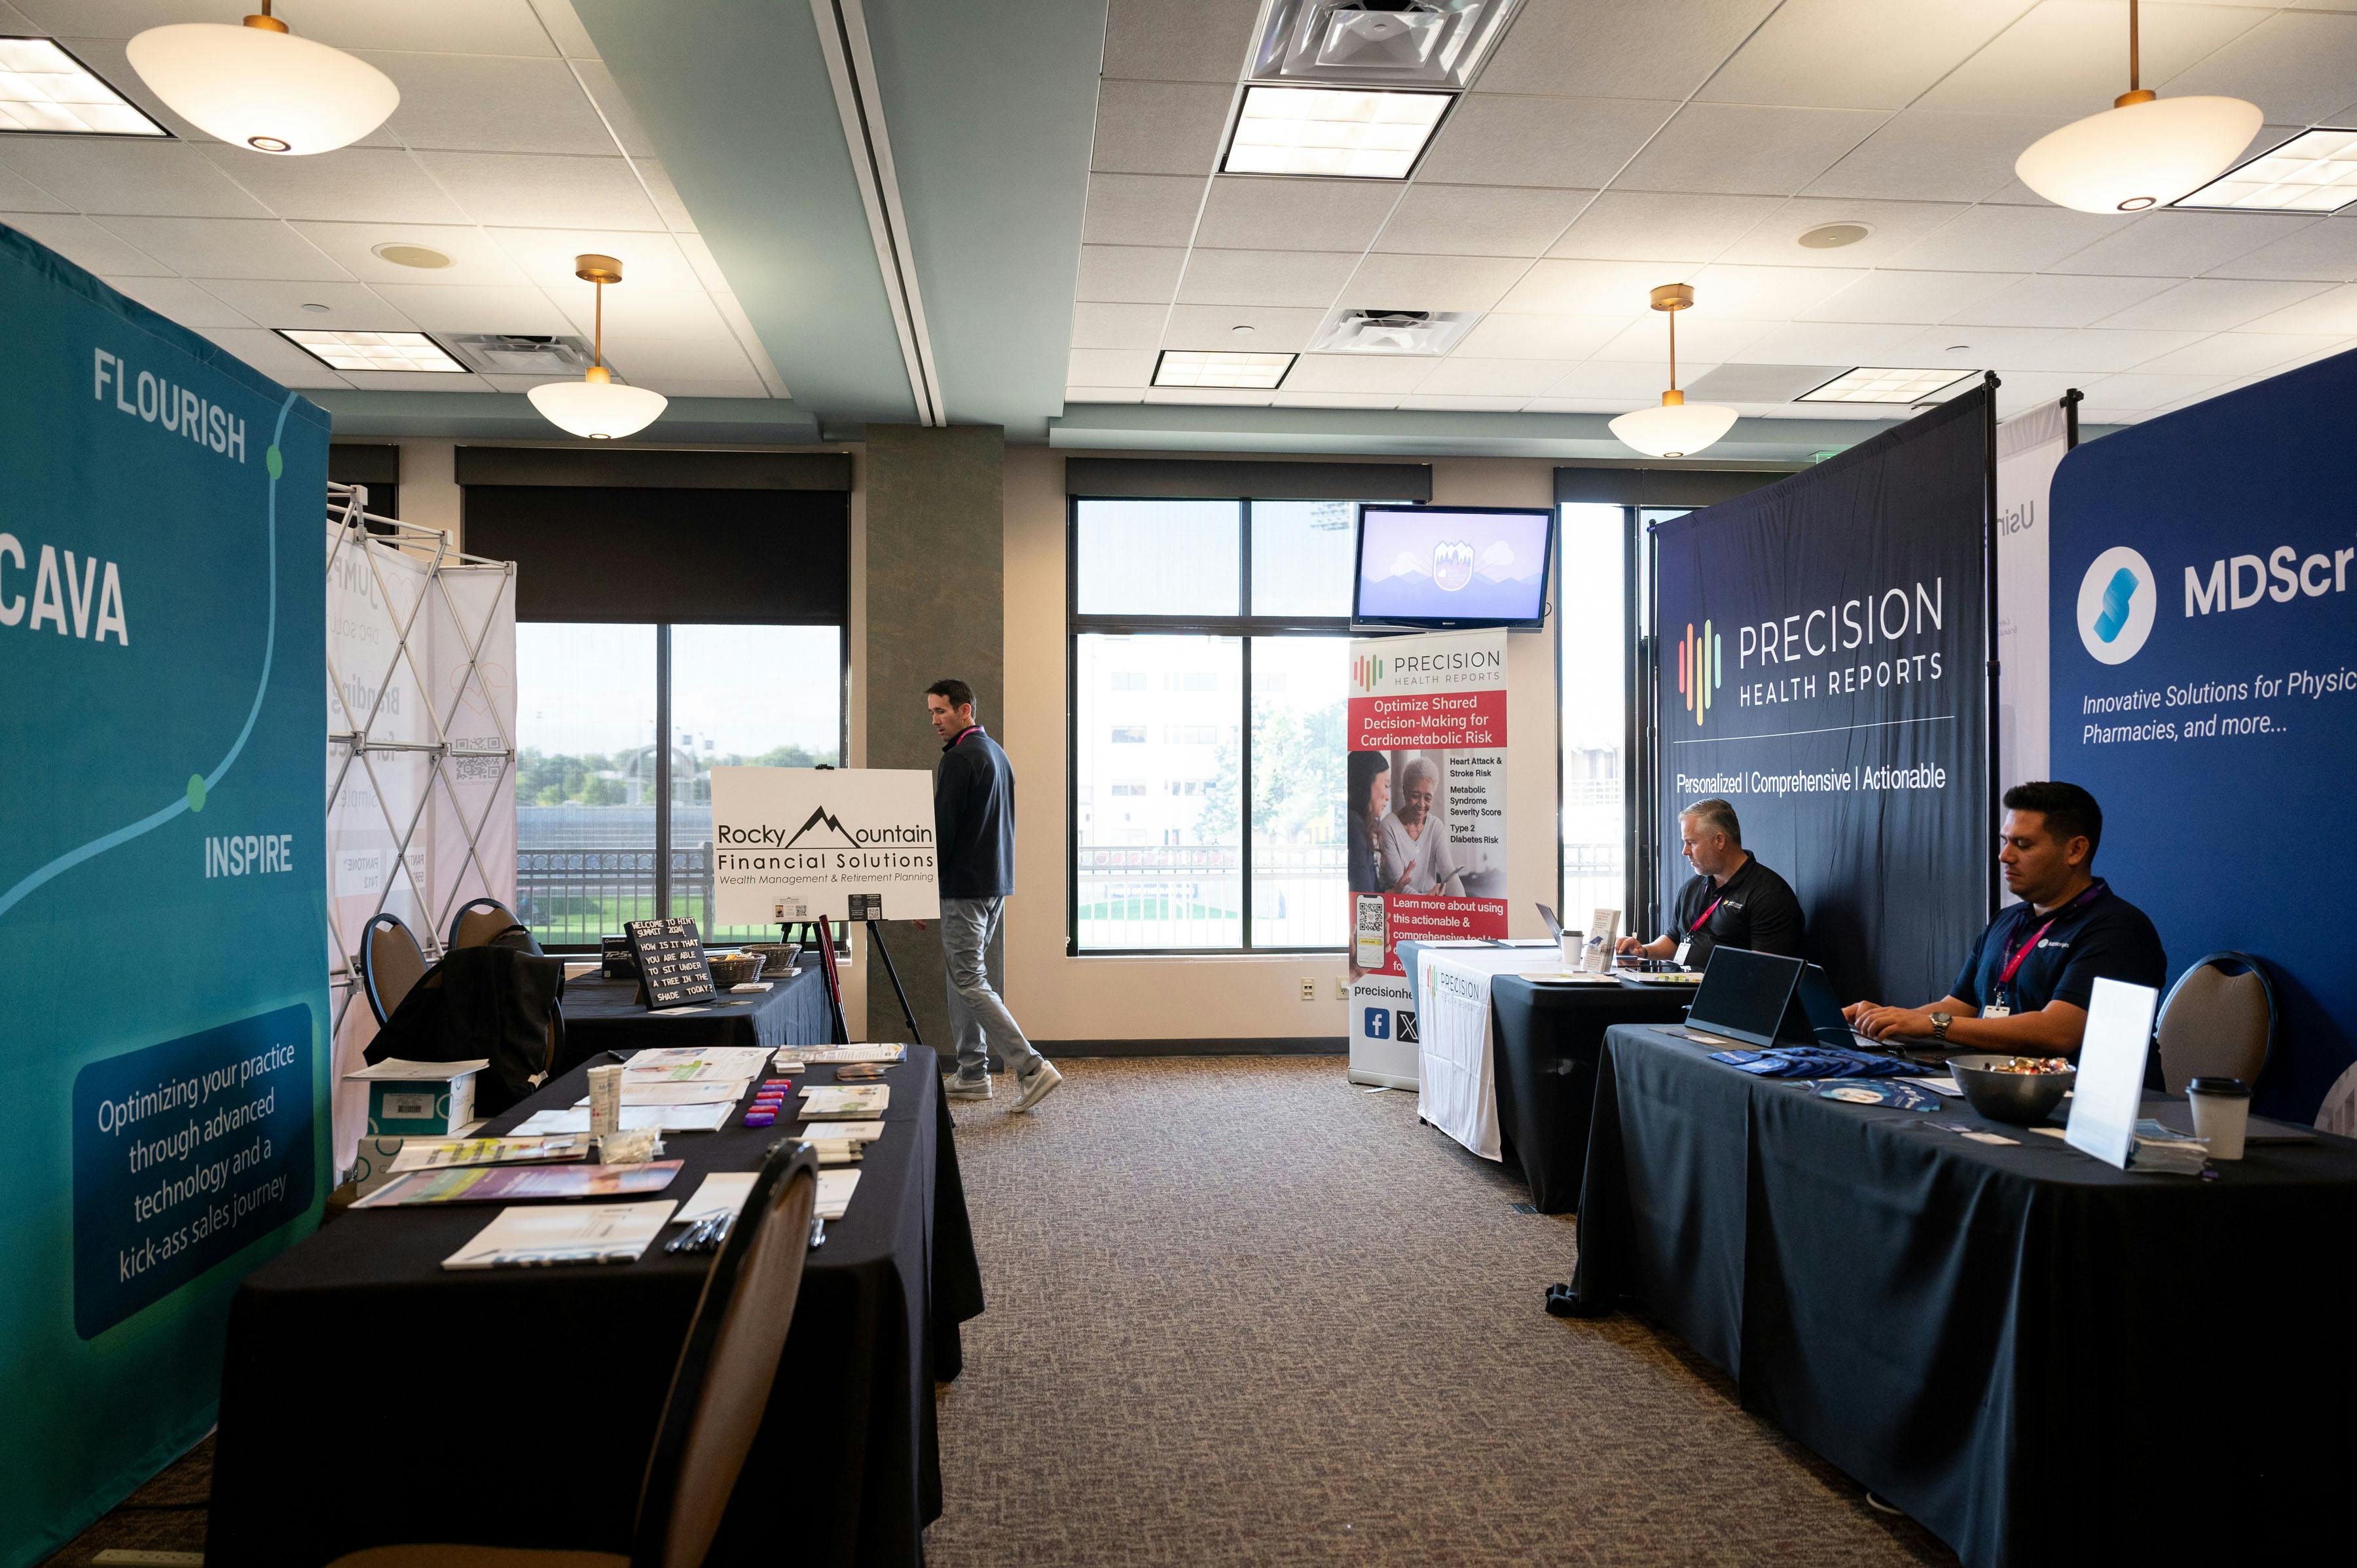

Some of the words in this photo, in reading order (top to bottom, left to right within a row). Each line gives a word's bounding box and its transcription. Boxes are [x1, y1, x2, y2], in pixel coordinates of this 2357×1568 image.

[95, 348, 245, 464] FLOURISH
[0, 533, 128, 646] CAVA
[2184, 545, 2354, 618] MDScr
[1740, 577, 1942, 669] PRECISION
[1395, 650, 1499, 672] PRECISION
[1395, 675, 1438, 685] HEALTH
[1446, 672, 1500, 683] REPORTS
[1740, 674, 1816, 707] HEALTH
[1829, 652, 1943, 696] REPORTS
[2083, 689, 2161, 714] Innovative
[2165, 682, 2248, 707] Solutions
[2254, 675, 2282, 699] for
[2287, 667, 2357, 700] Physic
[1374, 699, 1429, 715] Optimize
[1432, 695, 1477, 710] Shared
[1364, 714, 1467, 729] Decision-Making
[1471, 713, 1489, 726] for
[2083, 719, 2179, 744] Pharmacies,
[2184, 714, 2217, 738] and
[2221, 715, 2287, 735] more...
[1361, 731, 1462, 746] Cardiometabolic
[1466, 731, 1493, 744] Risk
[1676, 771, 1742, 794] Personalized
[1751, 767, 1852, 798] Comprehensive
[1863, 762, 1946, 790] Actionable
[1450, 797, 1487, 806] Syndrome
[1450, 808, 1480, 817] Severity
[718, 824, 786, 847] Rocky
[1450, 824, 1469, 833] Type
[206, 835, 293, 878] INSPIRE
[718, 854, 825, 870] Financial
[837, 853, 933, 868] Solutions
[720, 875, 756, 884] Wealth
[759, 874, 828, 884] Management
[831, 874, 838, 883] &
[841, 873, 892, 883] Retirement
[894, 872, 934, 883] Planning
[1393, 898, 1419, 908] Learn
[1421, 901, 1446, 910] more
[1448, 901, 1476, 911] about
[1478, 902, 1503, 915] using
[632, 920, 664, 930] WELCOME
[1393, 913, 1410, 924] this
[1412, 915, 1460, 927] actionable
[1462, 917, 1471, 928] &
[637, 928, 661, 938] SUMMIT
[640, 943, 656, 951] HOW
[681, 939, 698, 947] THAT
[646, 956, 660, 964] YOU
[663, 953, 676, 962] ARE
[680, 951, 696, 960] ABLE
[648, 967, 659, 975] TO
[663, 965, 676, 974] SIT
[679, 962, 702, 971] UNDER
[661, 977, 680, 987] TREE
[695, 973, 708, 981] THE
[1441, 972, 1478, 1001] PRECISION
[657, 991, 680, 1001] SHADE
[686, 984, 713, 996] TODAY?
[98, 1078, 198, 1137] Optimizing
[202, 1065, 237, 1104] your
[241, 1043, 295, 1088] practice
[129, 1119, 199, 1173] through
[204, 1086, 274, 1142] advanced
[134, 1158, 229, 1222] technology
[233, 1136, 260, 1175] and
[263, 1139, 271, 1158] a
[119, 1227, 188, 1283] kick-ass
[192, 1205, 229, 1243] sales
[232, 1173, 287, 1228] journey
